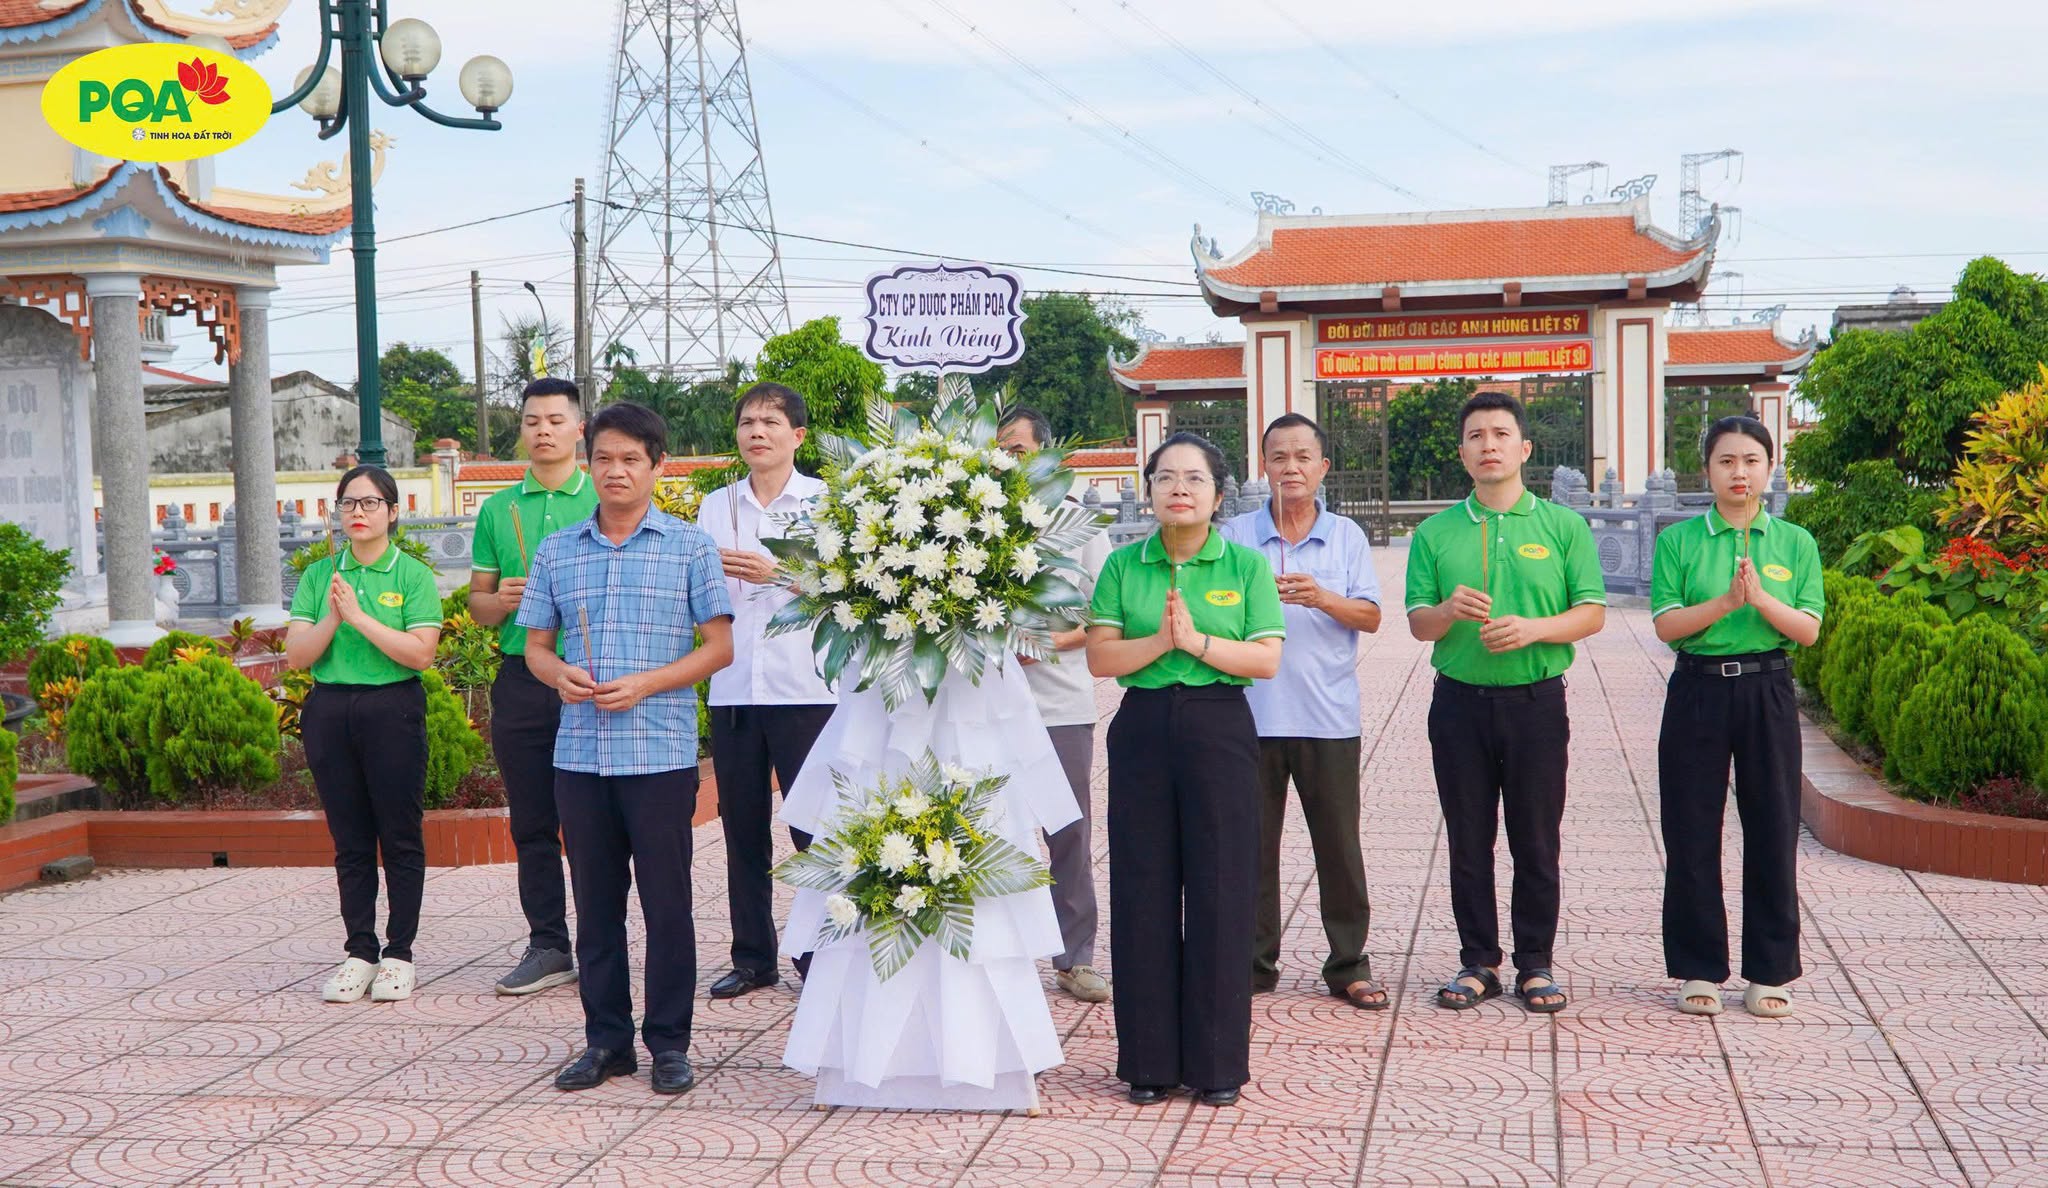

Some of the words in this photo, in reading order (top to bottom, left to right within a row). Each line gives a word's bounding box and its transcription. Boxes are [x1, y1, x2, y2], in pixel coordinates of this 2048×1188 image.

[879, 292, 899, 316] CTY
[902, 292, 916, 316] CP
[984, 292, 1005, 317] PQA
[878, 326, 932, 348] Kính
[940, 325, 1003, 352] Viếng
[1327, 322, 1349, 339] ĐỜI
[1352, 321, 1374, 339] ĐỜI
[1378, 320, 1406, 338] NHỚ
[1408, 321, 1427, 337] ƠN
[1431, 319, 1457, 336] CÁC
[1461, 320, 1489, 335] ANH
[1492, 316, 1529, 334] HÙNG
[1532, 315, 1560, 334] LIỆT
[1563, 314, 1580, 331] SỸ
[1480, 349, 1500, 369] CÁC
[1502, 351, 1521, 368] ANH
[1523, 348, 1550, 367] HÙNG
[1551, 346, 1571, 369] LIỆT
